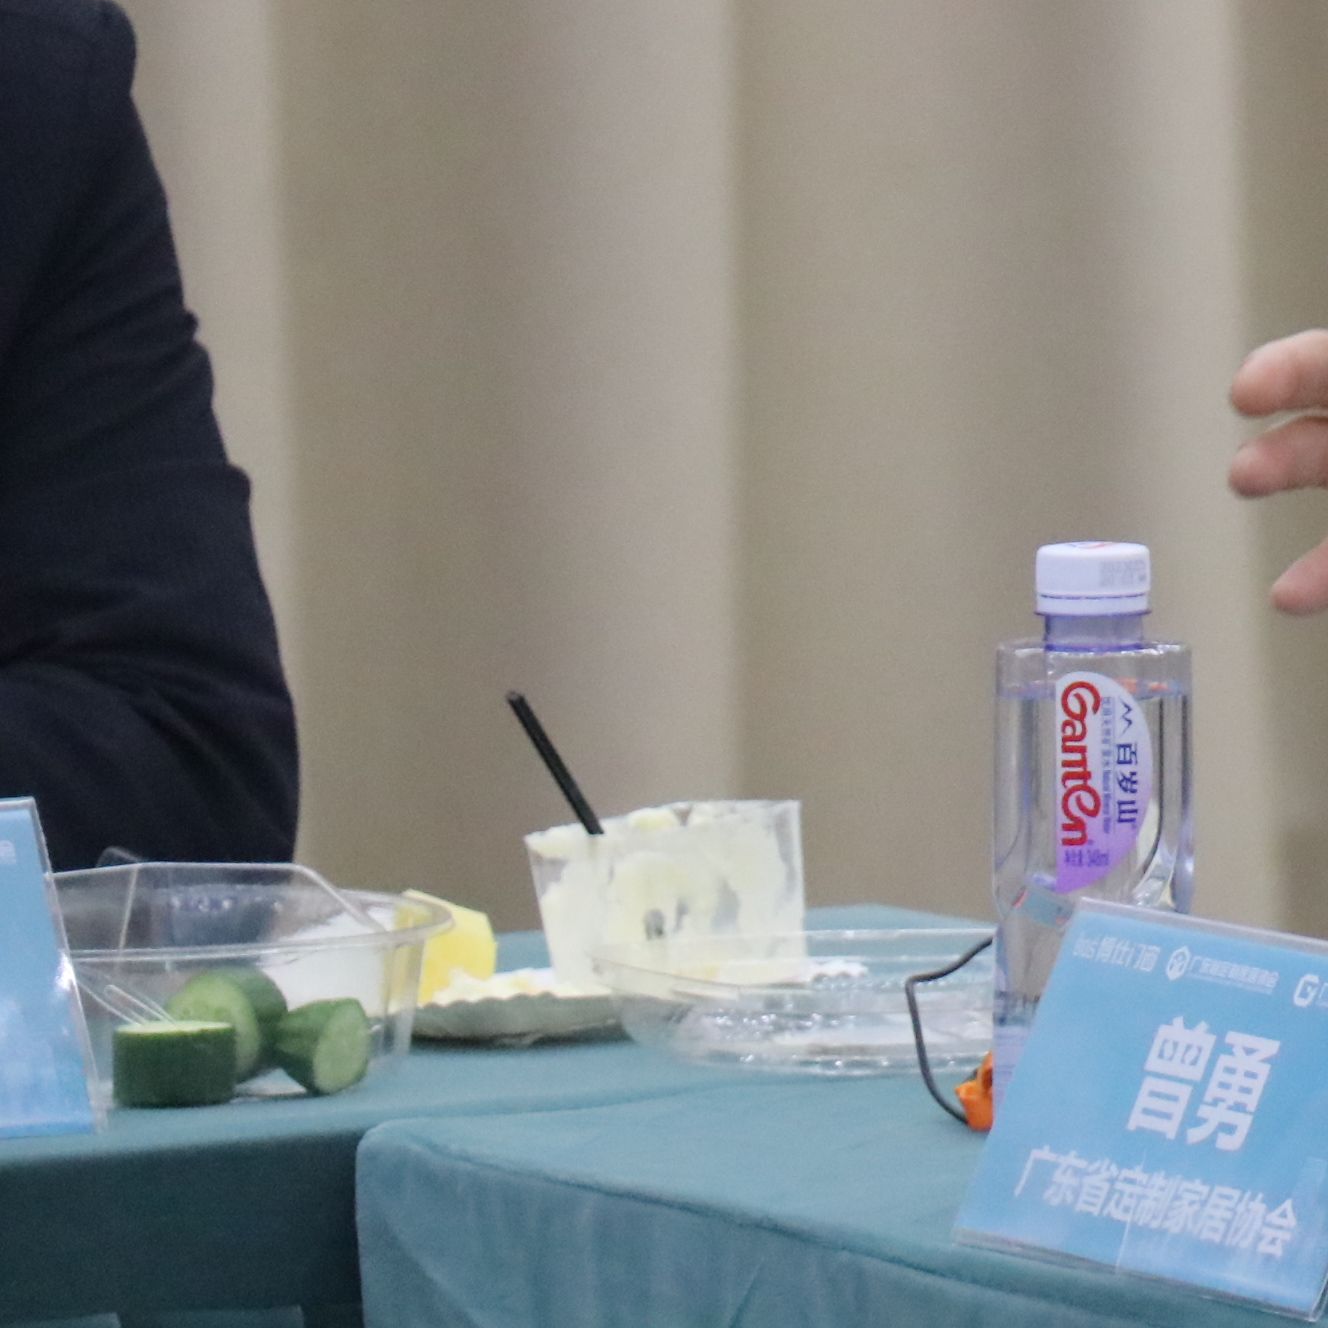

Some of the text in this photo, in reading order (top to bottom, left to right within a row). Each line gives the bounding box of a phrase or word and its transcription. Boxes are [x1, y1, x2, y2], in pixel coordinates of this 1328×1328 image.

[1116, 741, 1138, 823] 百岁山
[1126, 1015, 1281, 1152] 曾勇
[1013, 1144, 1298, 1257] 广东省定制家居协会
